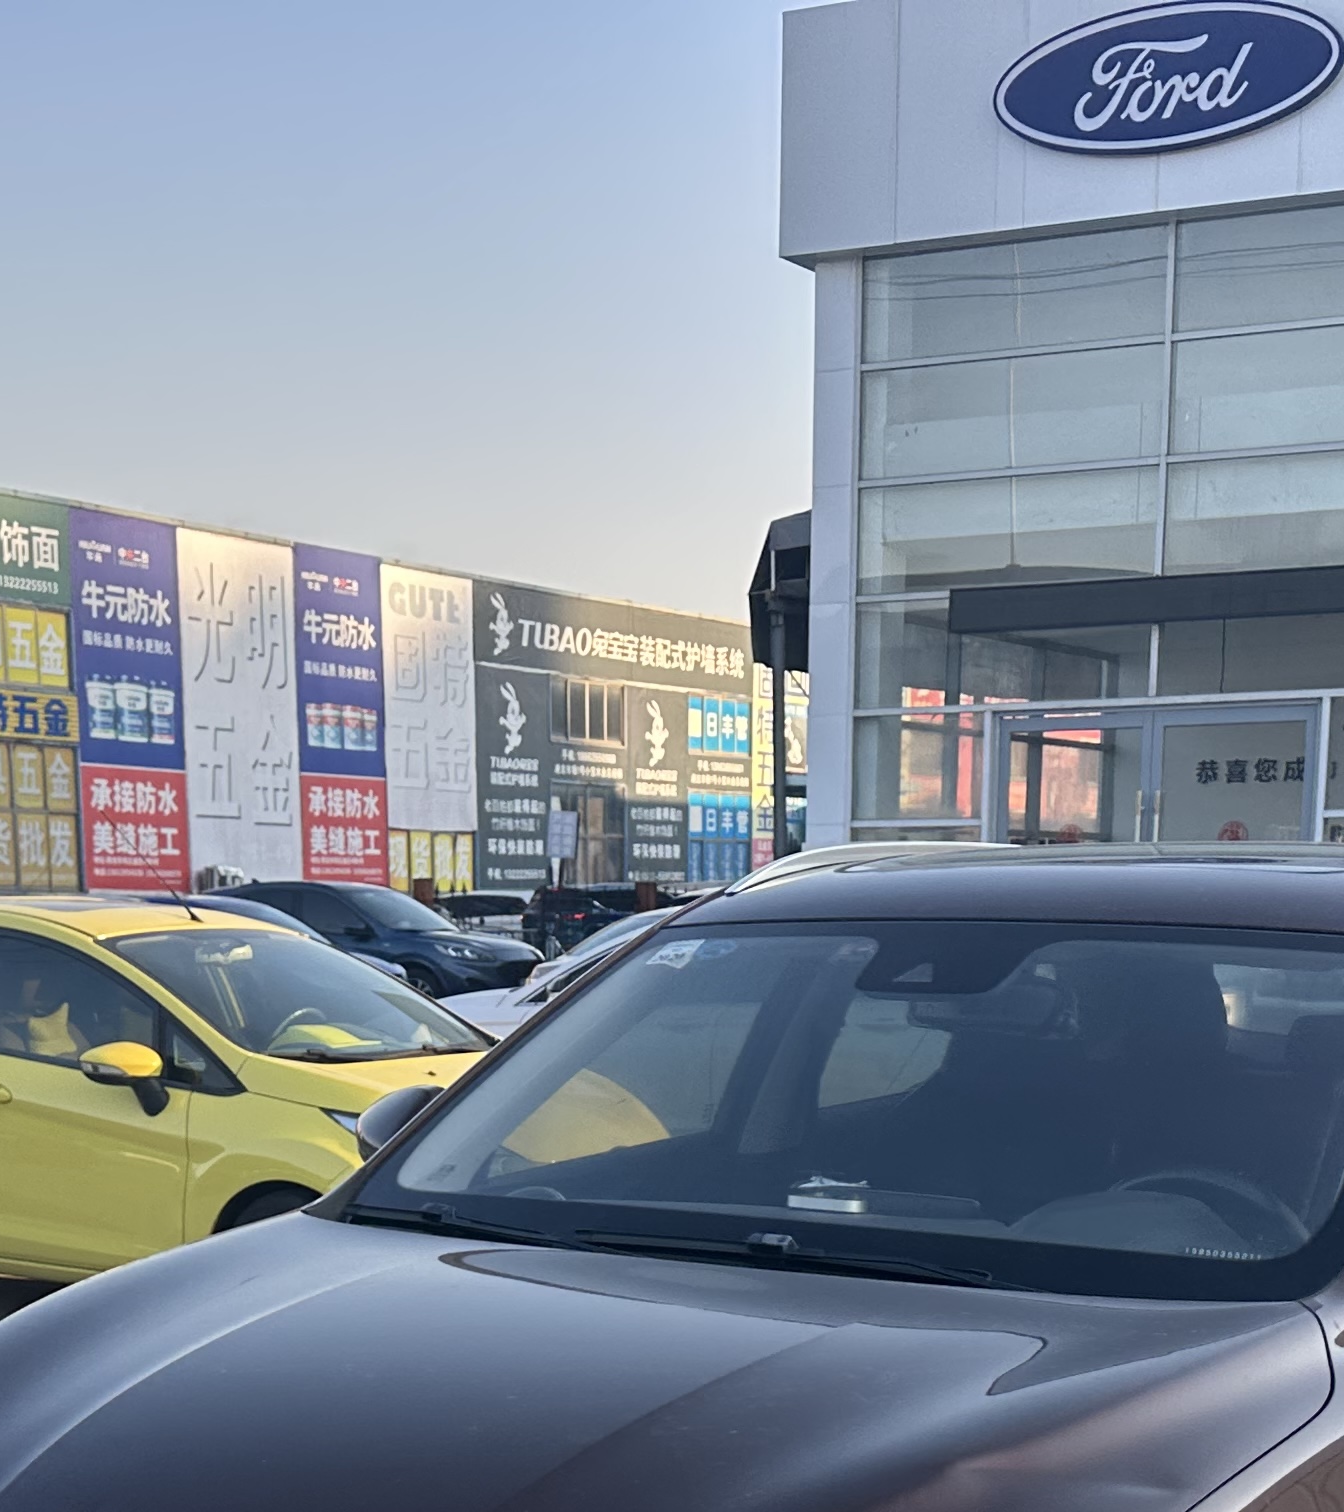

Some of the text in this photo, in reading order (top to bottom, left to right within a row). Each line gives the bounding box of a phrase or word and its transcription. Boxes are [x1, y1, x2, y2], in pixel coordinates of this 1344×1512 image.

[1073, 33, 1254, 132] Ford
[81, 580, 172, 627] 牛元防水
[303, 609, 376, 651] 牛元防水
[706, 711, 749, 742] 日丰管
[90, 778, 178, 815] 承接防水
[308, 785, 380, 820] 承接防水
[92, 821, 181, 857] 美缝施工
[705, 808, 750, 835] 日丰管
[309, 825, 381, 857] 美缝施工
